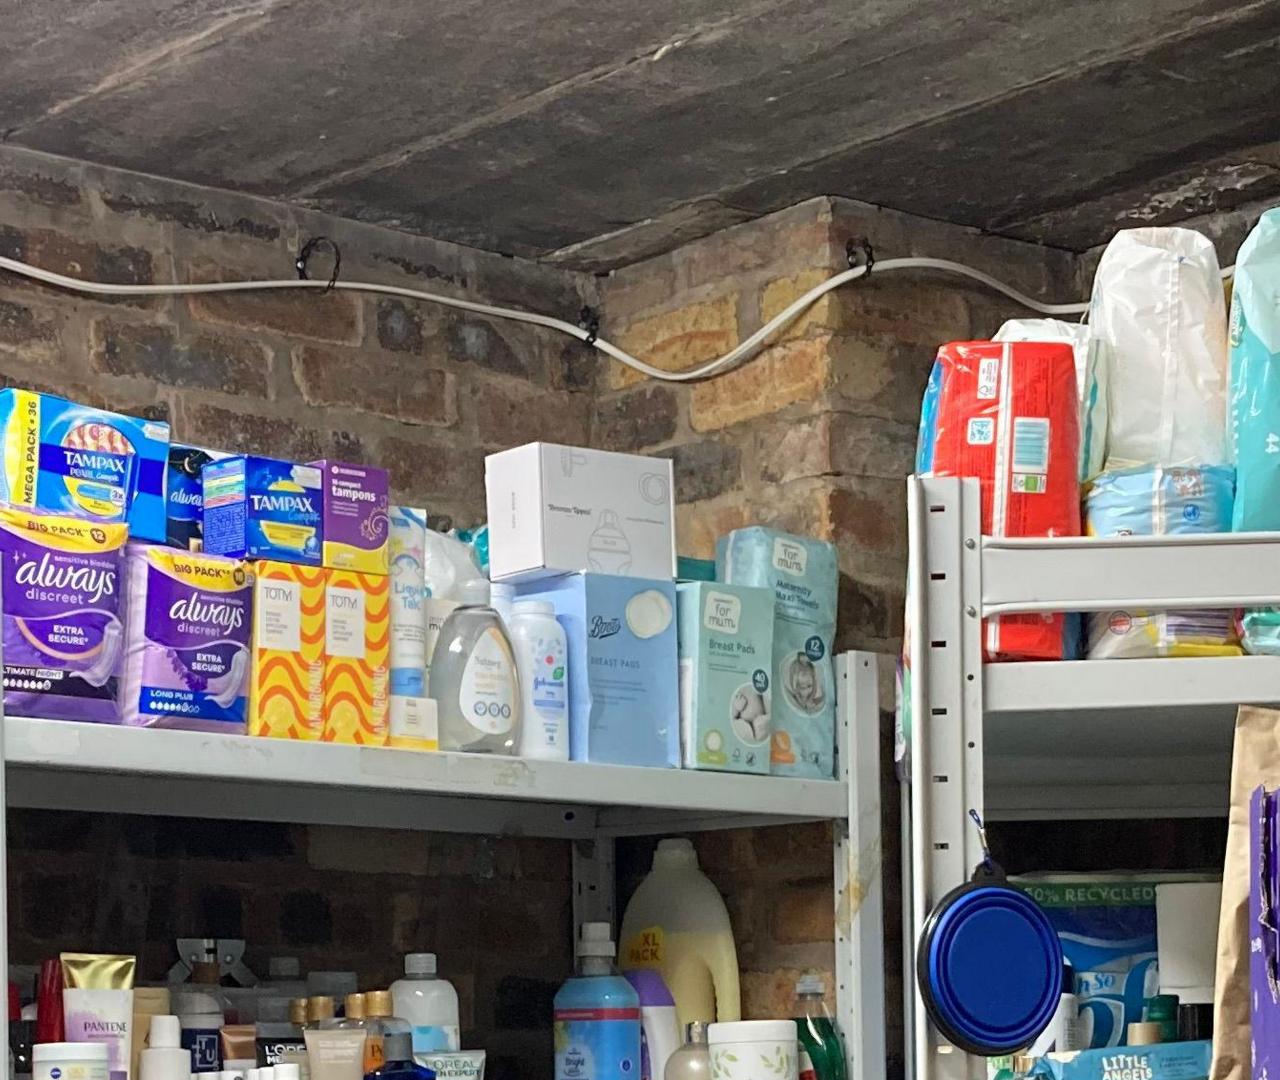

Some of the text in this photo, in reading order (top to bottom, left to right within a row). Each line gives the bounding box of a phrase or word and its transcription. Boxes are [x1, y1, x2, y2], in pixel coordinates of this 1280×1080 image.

[1265, 432, 1280, 454] 44
[24, 401, 37, 503] MEGA PACK 36
[64, 451, 125, 474] TAMPAX
[170, 488, 203, 511] alwa
[332, 485, 377, 502] tampons
[251, 496, 315, 513] TAMPAX
[27, 521, 49, 533] BIG
[783, 548, 798, 560] for
[175, 564, 192, 576] BIG
[16, 553, 116, 604] always
[26, 587, 84, 605] discreet
[170, 593, 245, 636] always
[715, 603, 731, 618] for
[53, 624, 84, 636] EXTRA
[177, 621, 221, 637] discreet
[708, 638, 756, 654] Breast Pads
[196, 652, 223, 664] EXTRA
[150, 689, 195, 701] LONG PLUS
[1065, 886, 1155, 902] RECYCLED
[641, 932, 661, 948] XL
[84, 1021, 128, 1034] PANTENE
[1102, 1054, 1148, 1072] LITTLE
[448, 1069, 481, 1077] EXPERT
